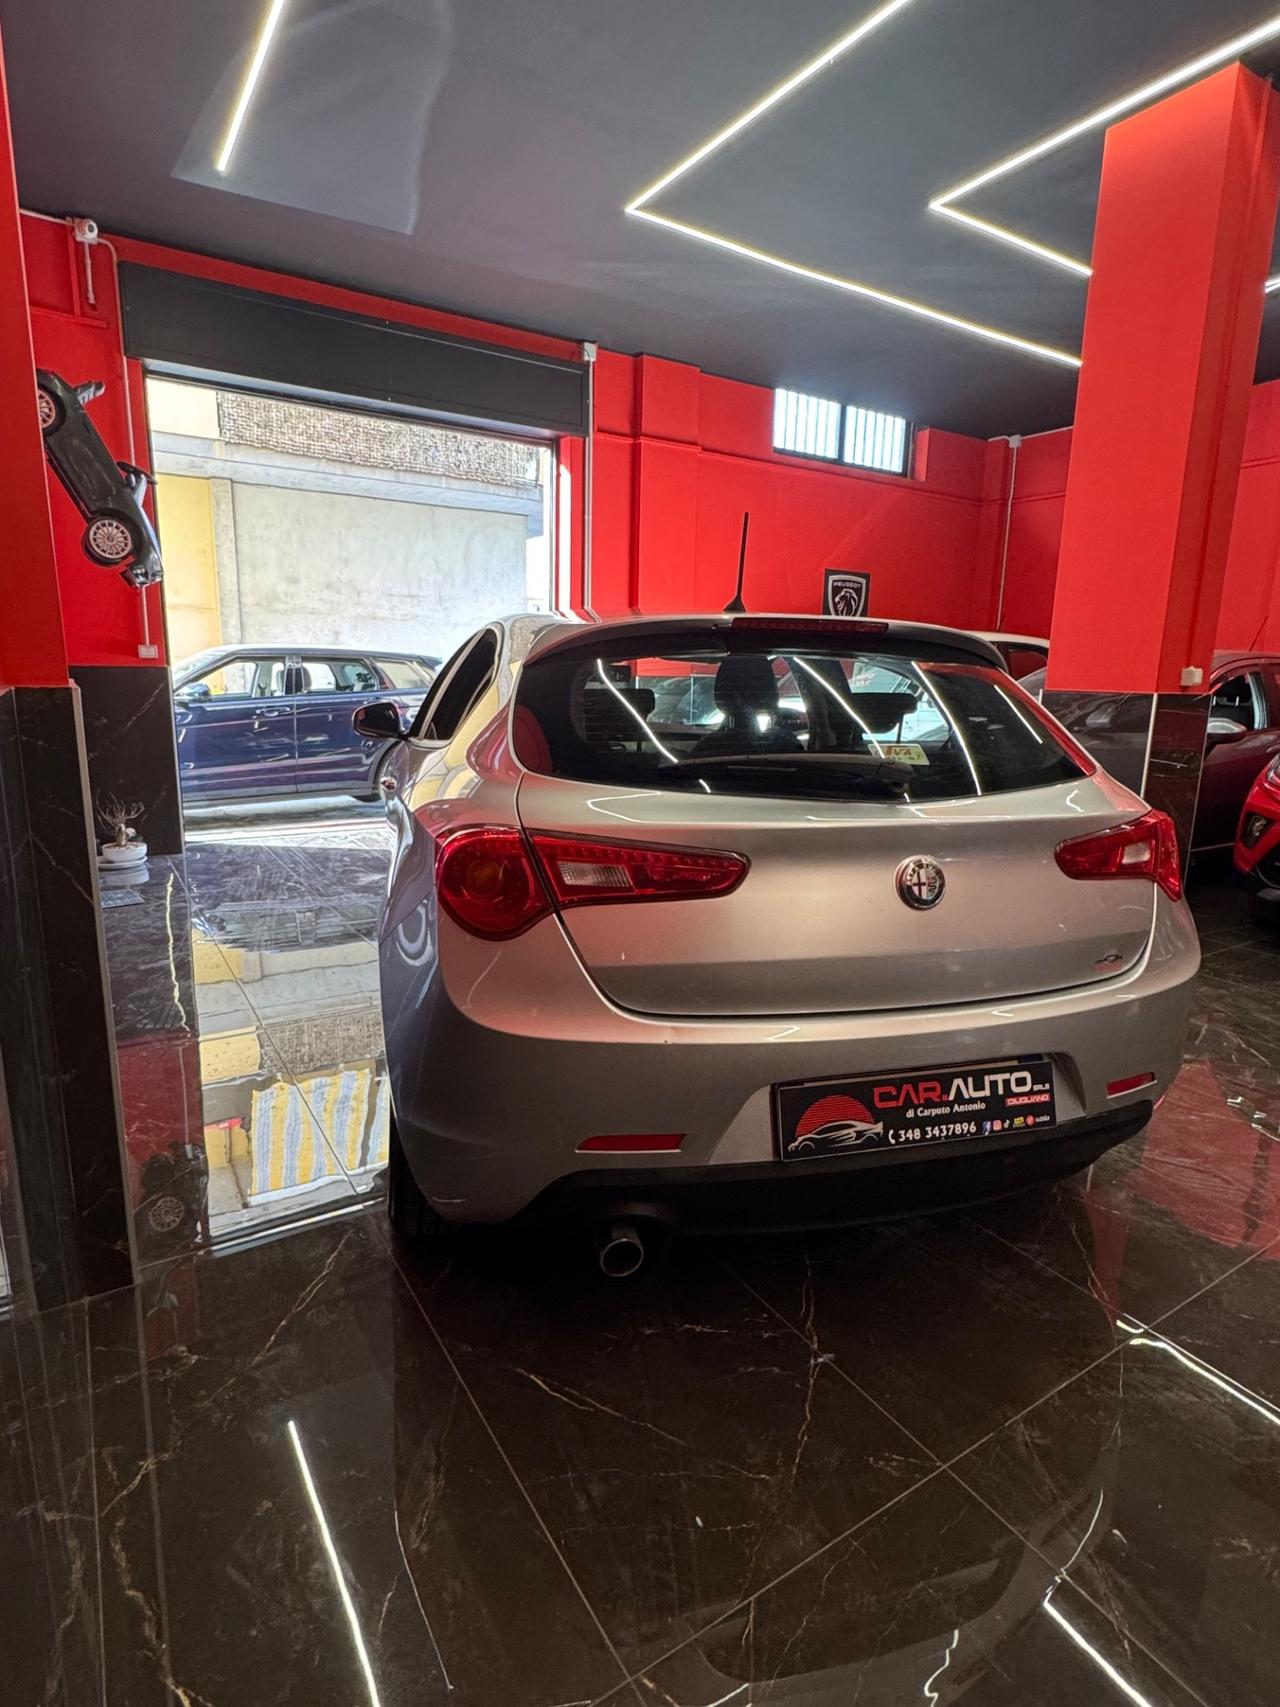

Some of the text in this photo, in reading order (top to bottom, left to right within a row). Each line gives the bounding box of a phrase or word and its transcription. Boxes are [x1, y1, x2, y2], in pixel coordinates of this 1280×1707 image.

[906, 1100, 986, 1118] di Carputo Antonio
[898, 1121, 977, 1142] 348 3437896
